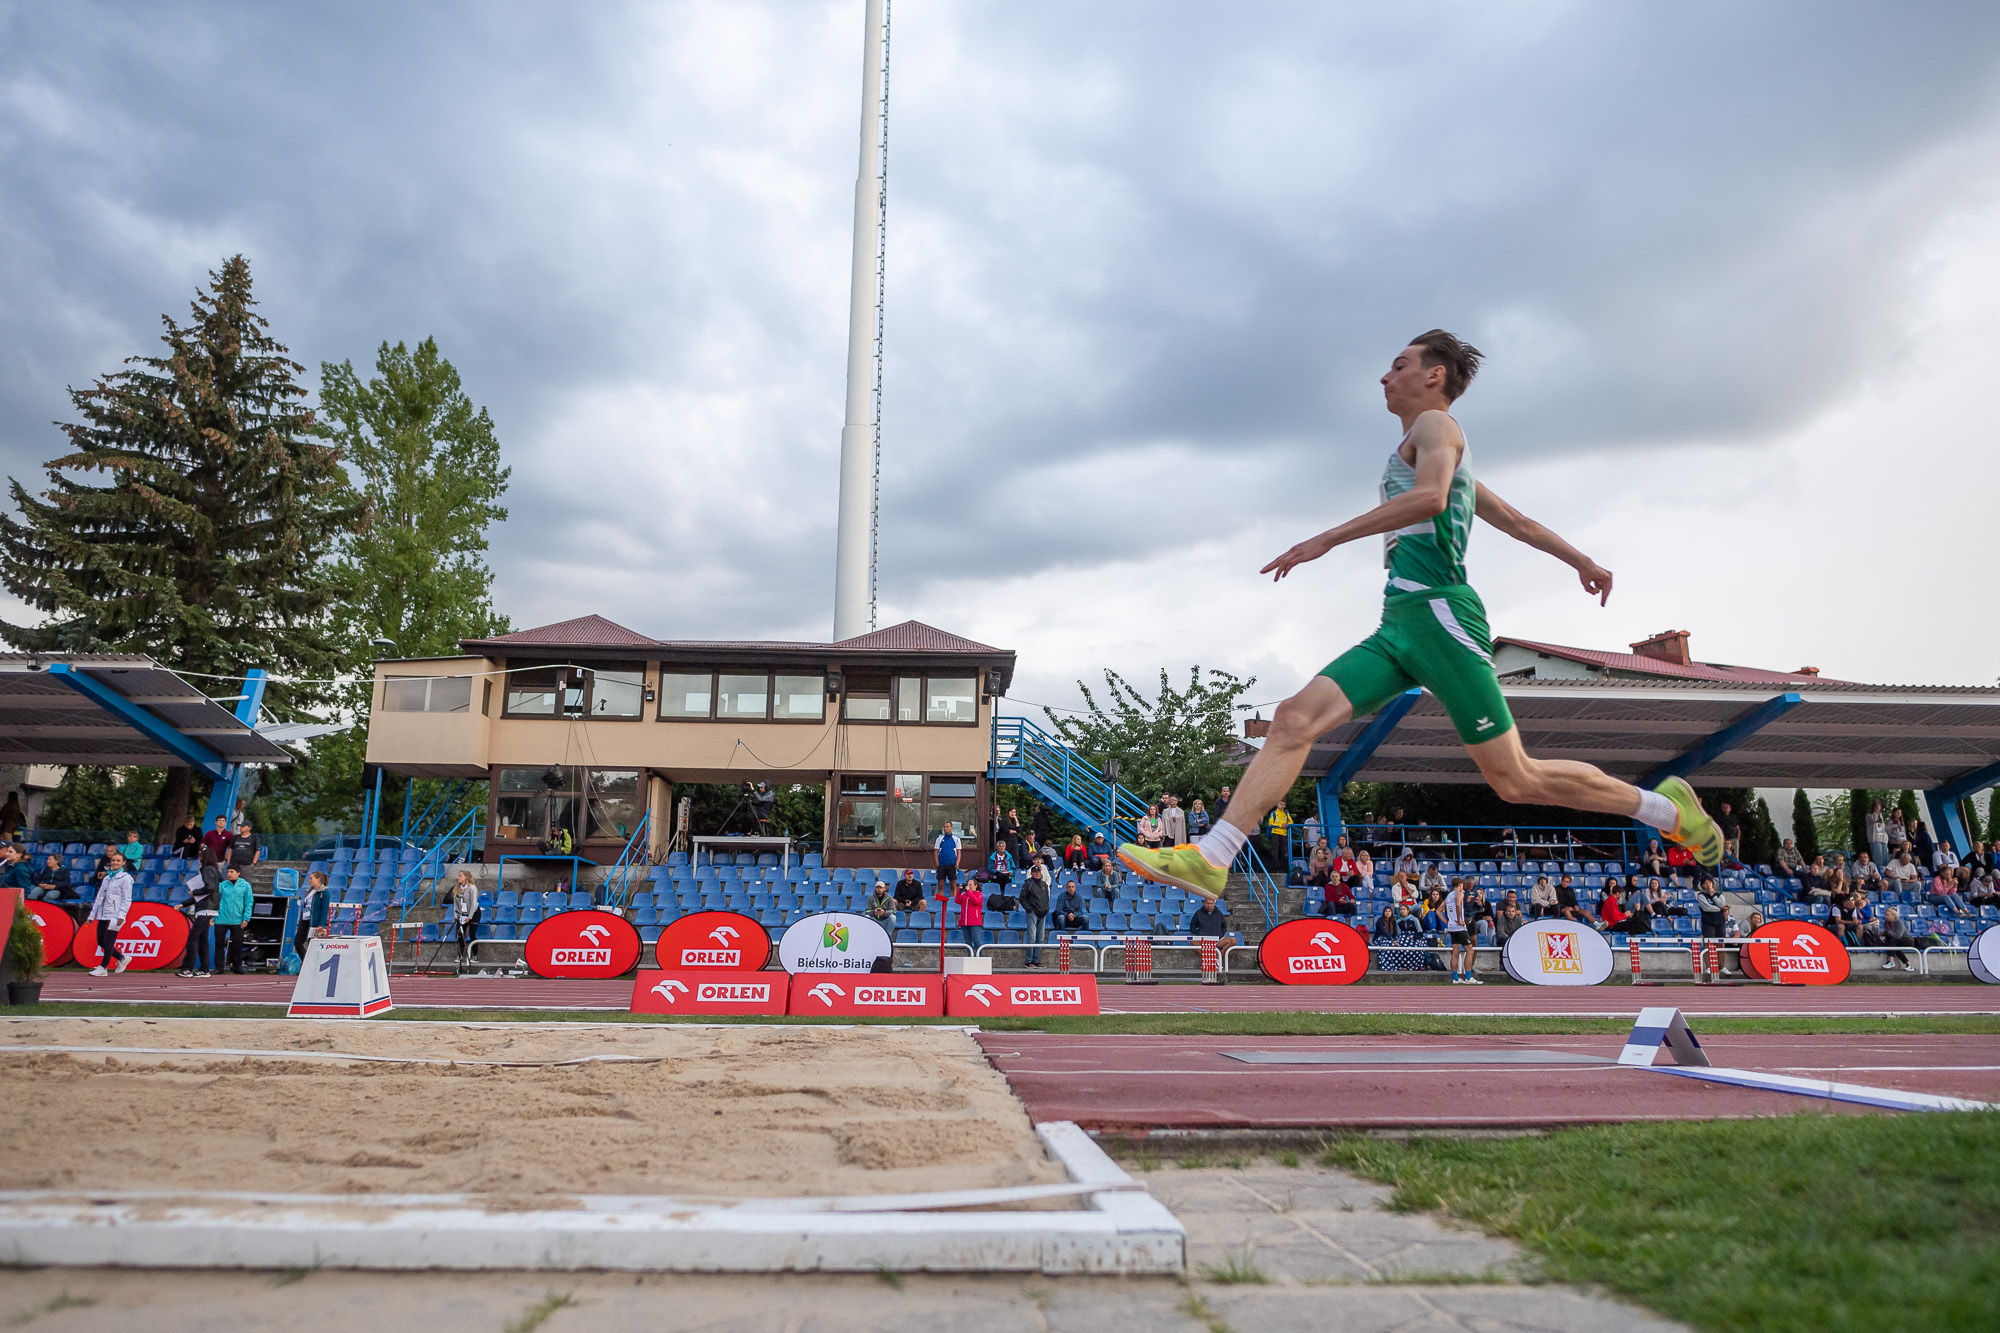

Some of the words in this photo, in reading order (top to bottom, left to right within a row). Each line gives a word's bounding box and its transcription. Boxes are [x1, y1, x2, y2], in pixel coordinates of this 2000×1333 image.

[101, 942, 156, 954] RLEN
[555, 951, 607, 963] ORLEN
[685, 952, 736, 964] ORLEN
[797, 957, 873, 969] Bielsko-Biała
[1292, 958, 1342, 970] ORLEN
[1544, 960, 1580, 971] PZLA
[1779, 959, 1825, 970] ORLEN
[319, 954, 340, 997] 1
[368, 952, 378, 993] 1
[702, 986, 765, 999] ORLEN
[858, 989, 922, 1002] ORLEN
[1015, 989, 1077, 1002] ORLEN
